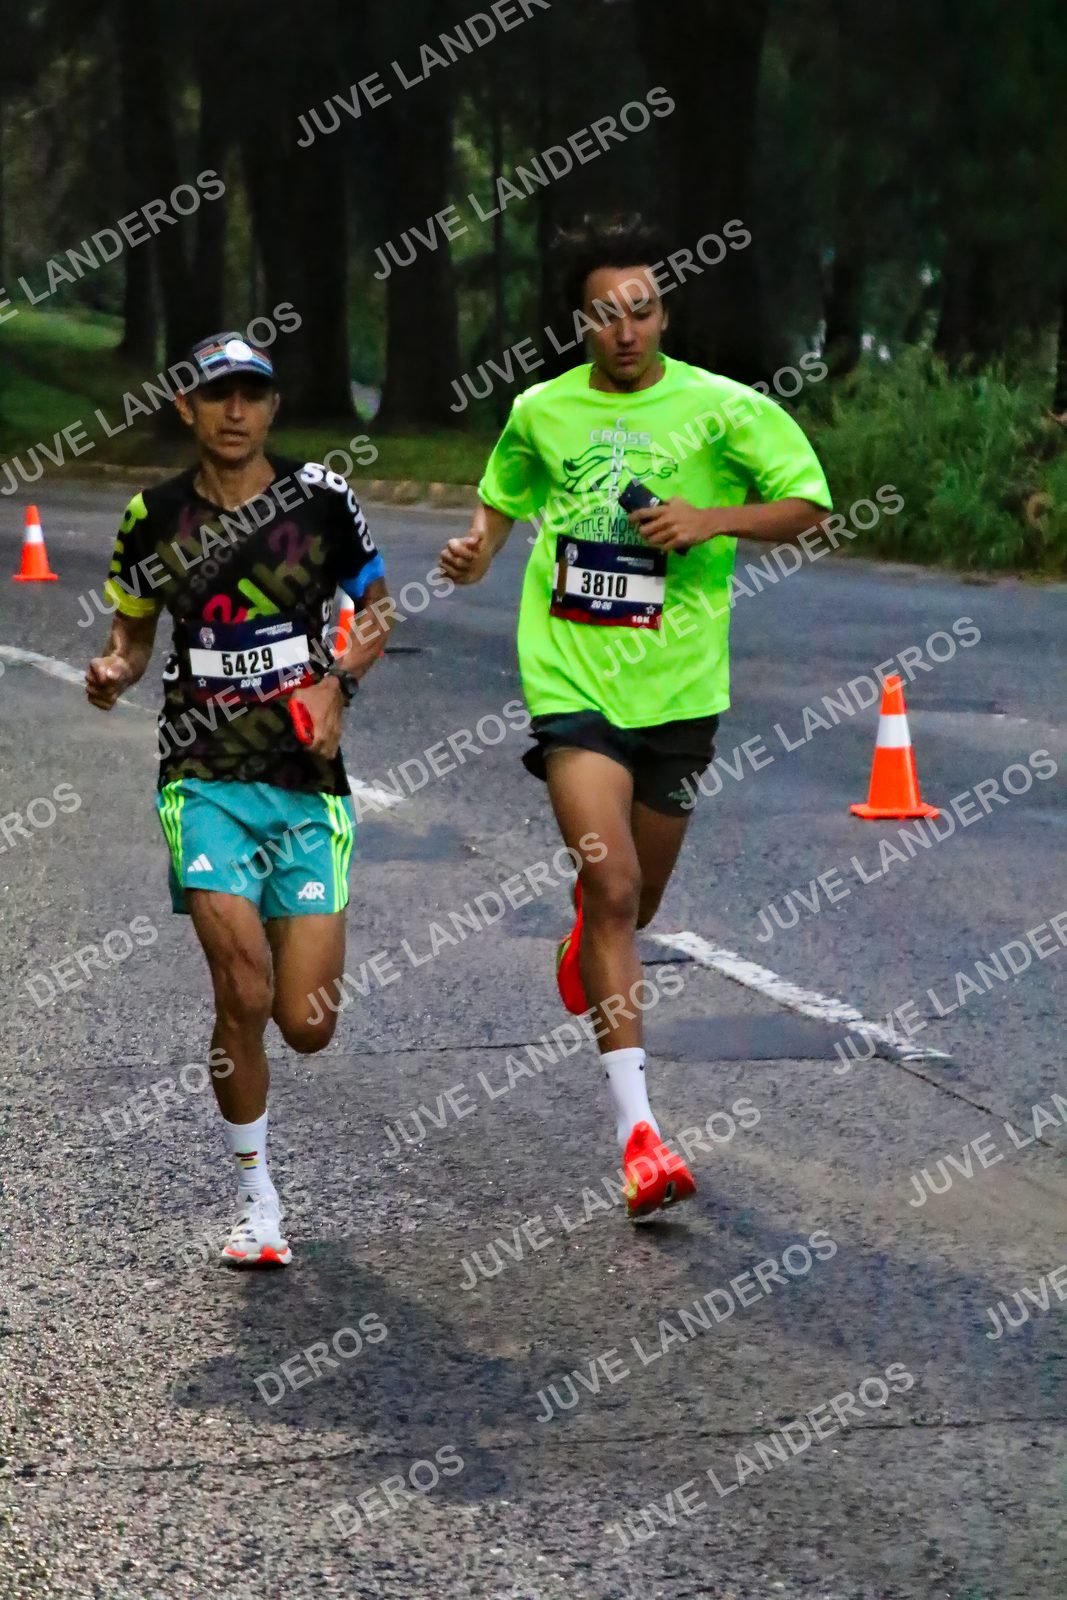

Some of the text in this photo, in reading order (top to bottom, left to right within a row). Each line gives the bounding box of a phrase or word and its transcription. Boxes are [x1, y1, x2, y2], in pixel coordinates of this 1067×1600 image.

[590, 430, 651, 446] CROSS
[571, 516, 604, 536] ETTLE
[581, 570, 628, 598] 3810
[221, 646, 274, 676] 5429
